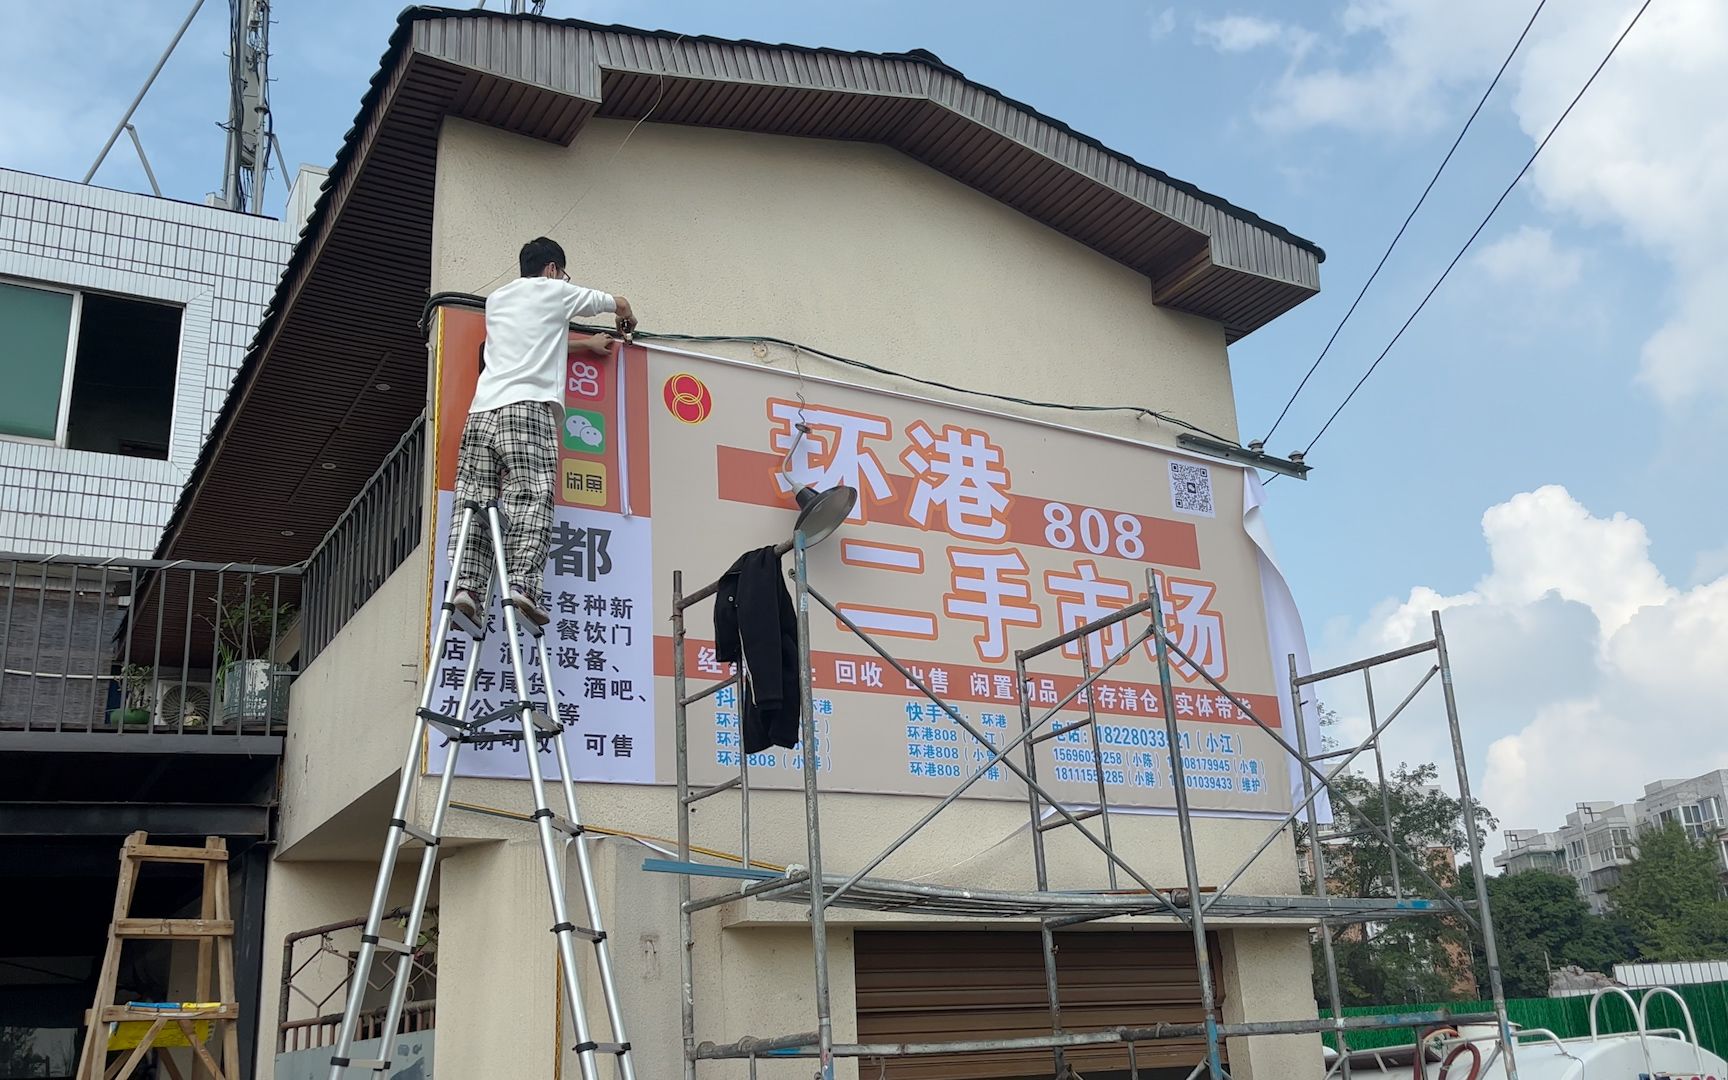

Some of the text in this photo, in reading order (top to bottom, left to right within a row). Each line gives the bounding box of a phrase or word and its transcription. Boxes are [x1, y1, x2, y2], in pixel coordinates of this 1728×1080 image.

[566, 471, 603, 494] 闲鱼
[766, 397, 1145, 560] 环港 808
[548, 520, 613, 583] 都
[836, 537, 1229, 683] 二手市场
[835, 660, 883, 688] 回收
[905, 666, 949, 694] 出售
[970, 671, 1058, 704] 闲置物品
